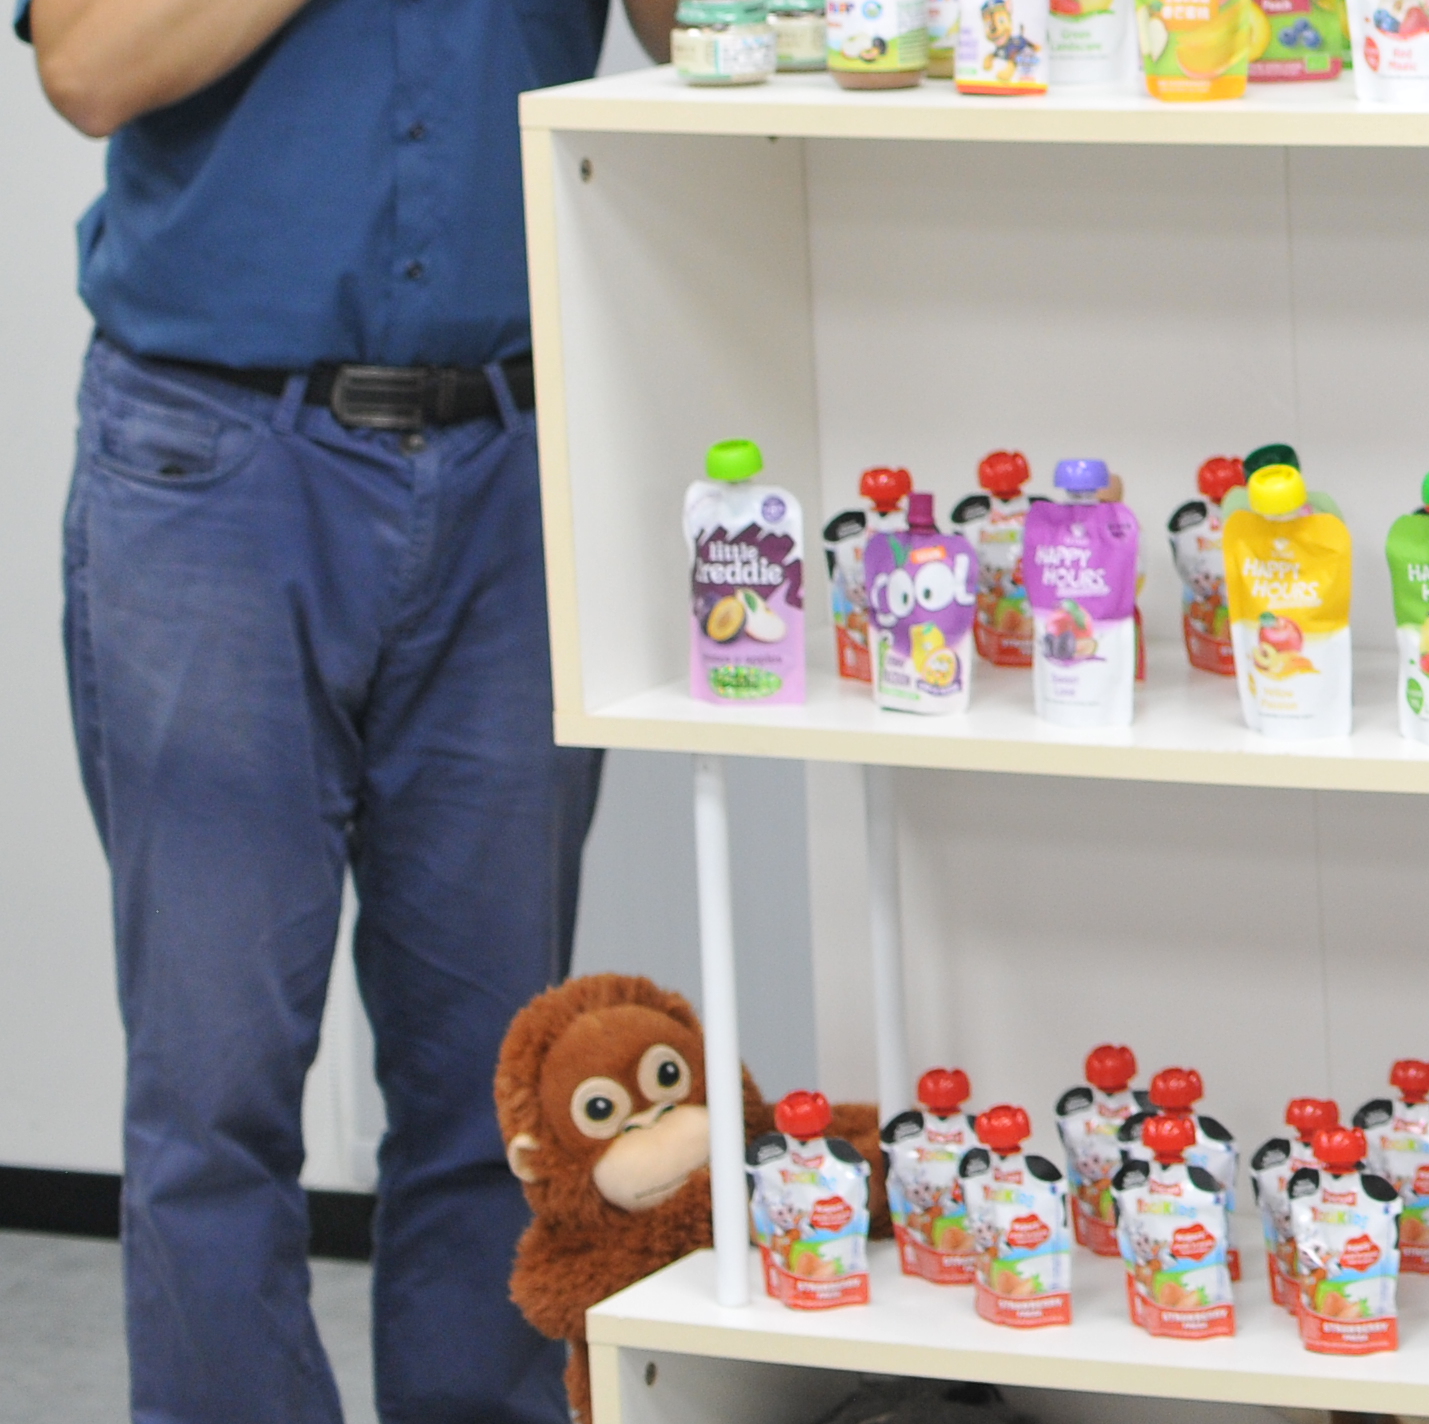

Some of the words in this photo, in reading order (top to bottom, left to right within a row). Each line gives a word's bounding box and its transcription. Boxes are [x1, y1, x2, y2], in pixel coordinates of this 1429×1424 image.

[708, 541, 759, 561] little
[1035, 544, 1092, 567] HAPPY
[1243, 557, 1300, 580] HAPPY
[1251, 579, 1320, 599] HOURS
